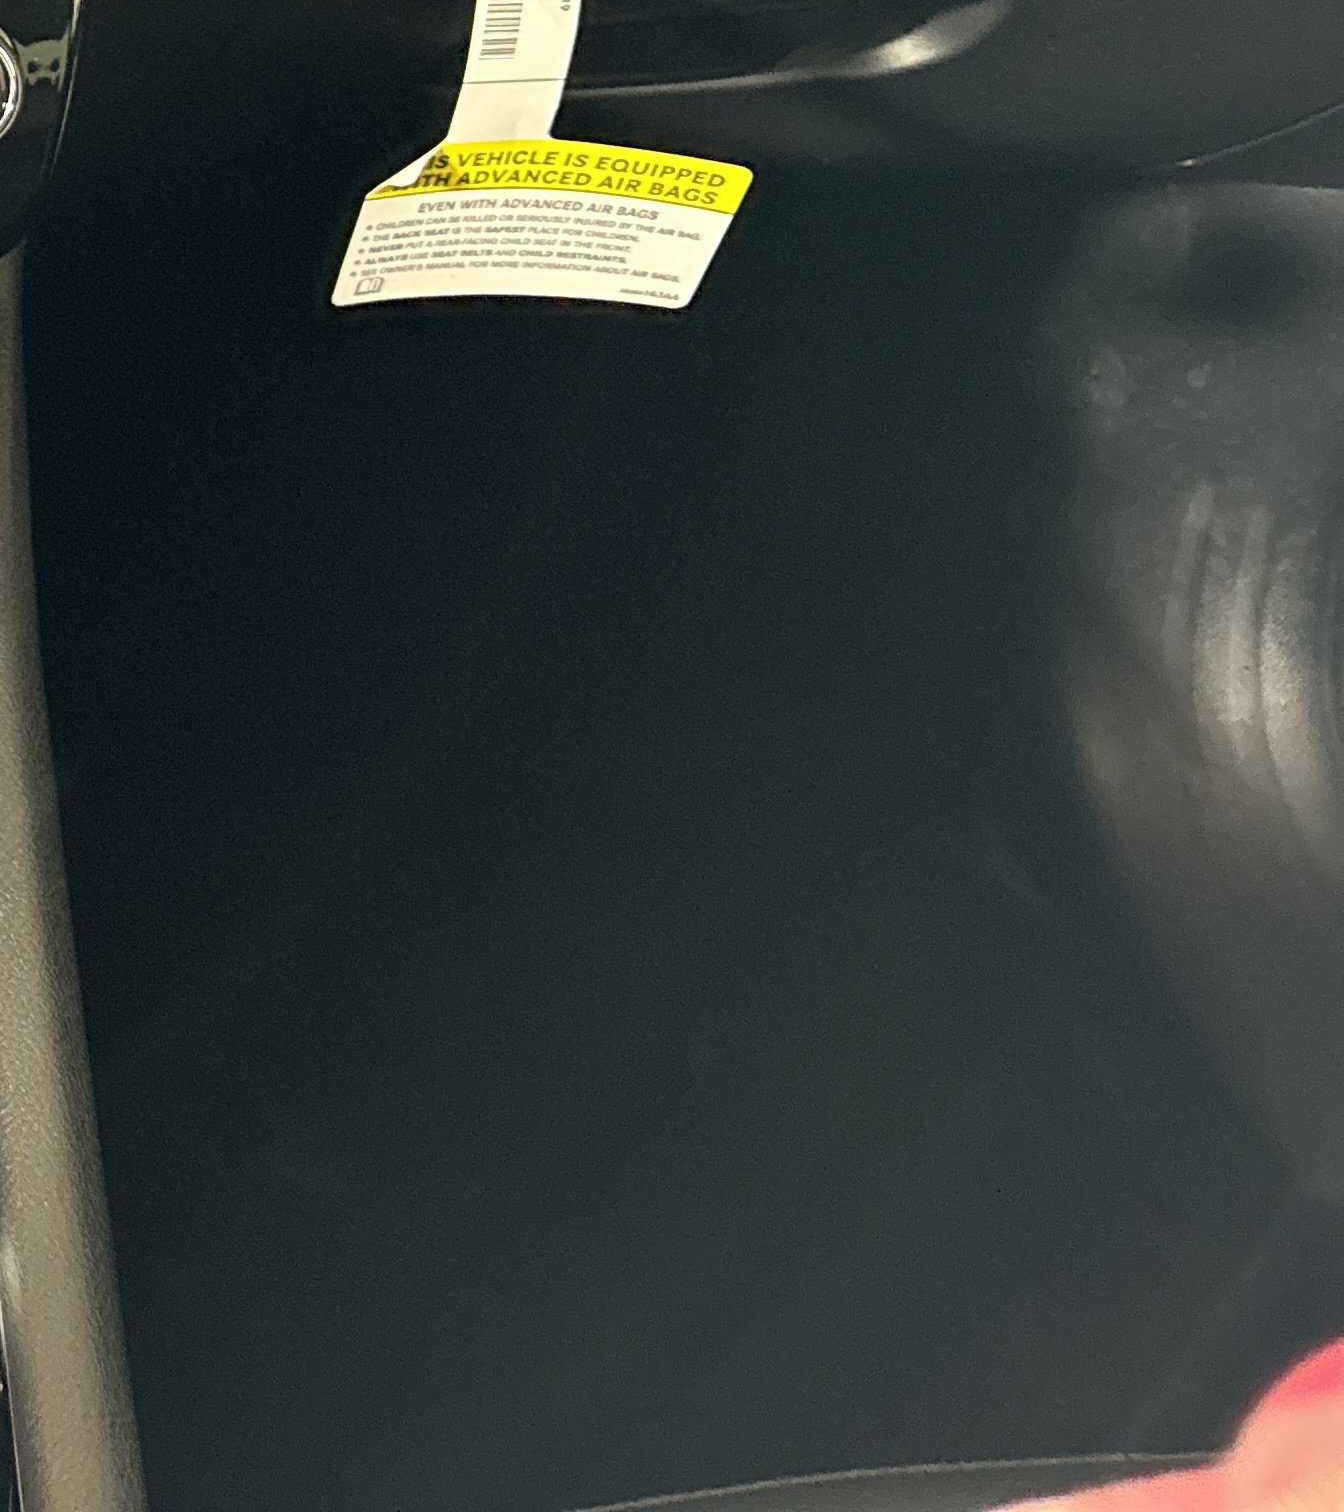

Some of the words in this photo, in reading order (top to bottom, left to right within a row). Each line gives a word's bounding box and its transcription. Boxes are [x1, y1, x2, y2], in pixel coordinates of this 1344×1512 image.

[457, 150, 560, 167] VEHICLE
[563, 152, 590, 168] IS
[594, 156, 726, 187] EQUIPPED
[455, 169, 592, 186] ADVANCED
[596, 175, 642, 192] AIR
[648, 182, 719, 205] BAGS
[418, 200, 457, 213] EVEN
[460, 199, 497, 209] WITH
[500, 198, 583, 211] ADVANCED
[586, 203, 613, 214] AIR
[616, 206, 659, 220] BAGS
